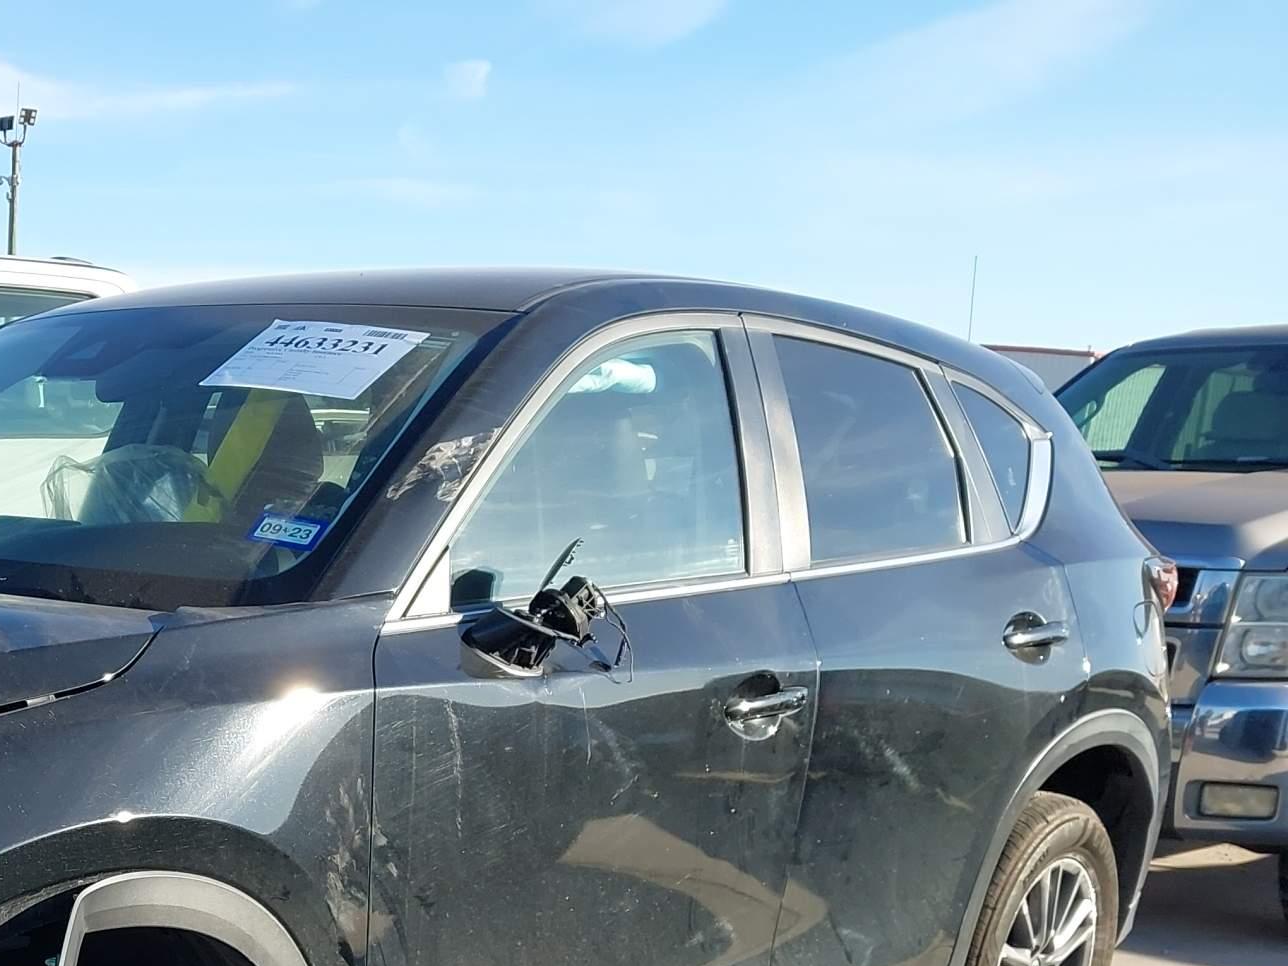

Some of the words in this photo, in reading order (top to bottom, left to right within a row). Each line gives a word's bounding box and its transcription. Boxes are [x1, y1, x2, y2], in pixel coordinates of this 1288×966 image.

[264, 334, 389, 356] 44633231
[260, 522, 283, 534] 09
[288, 527, 313, 540] 23
